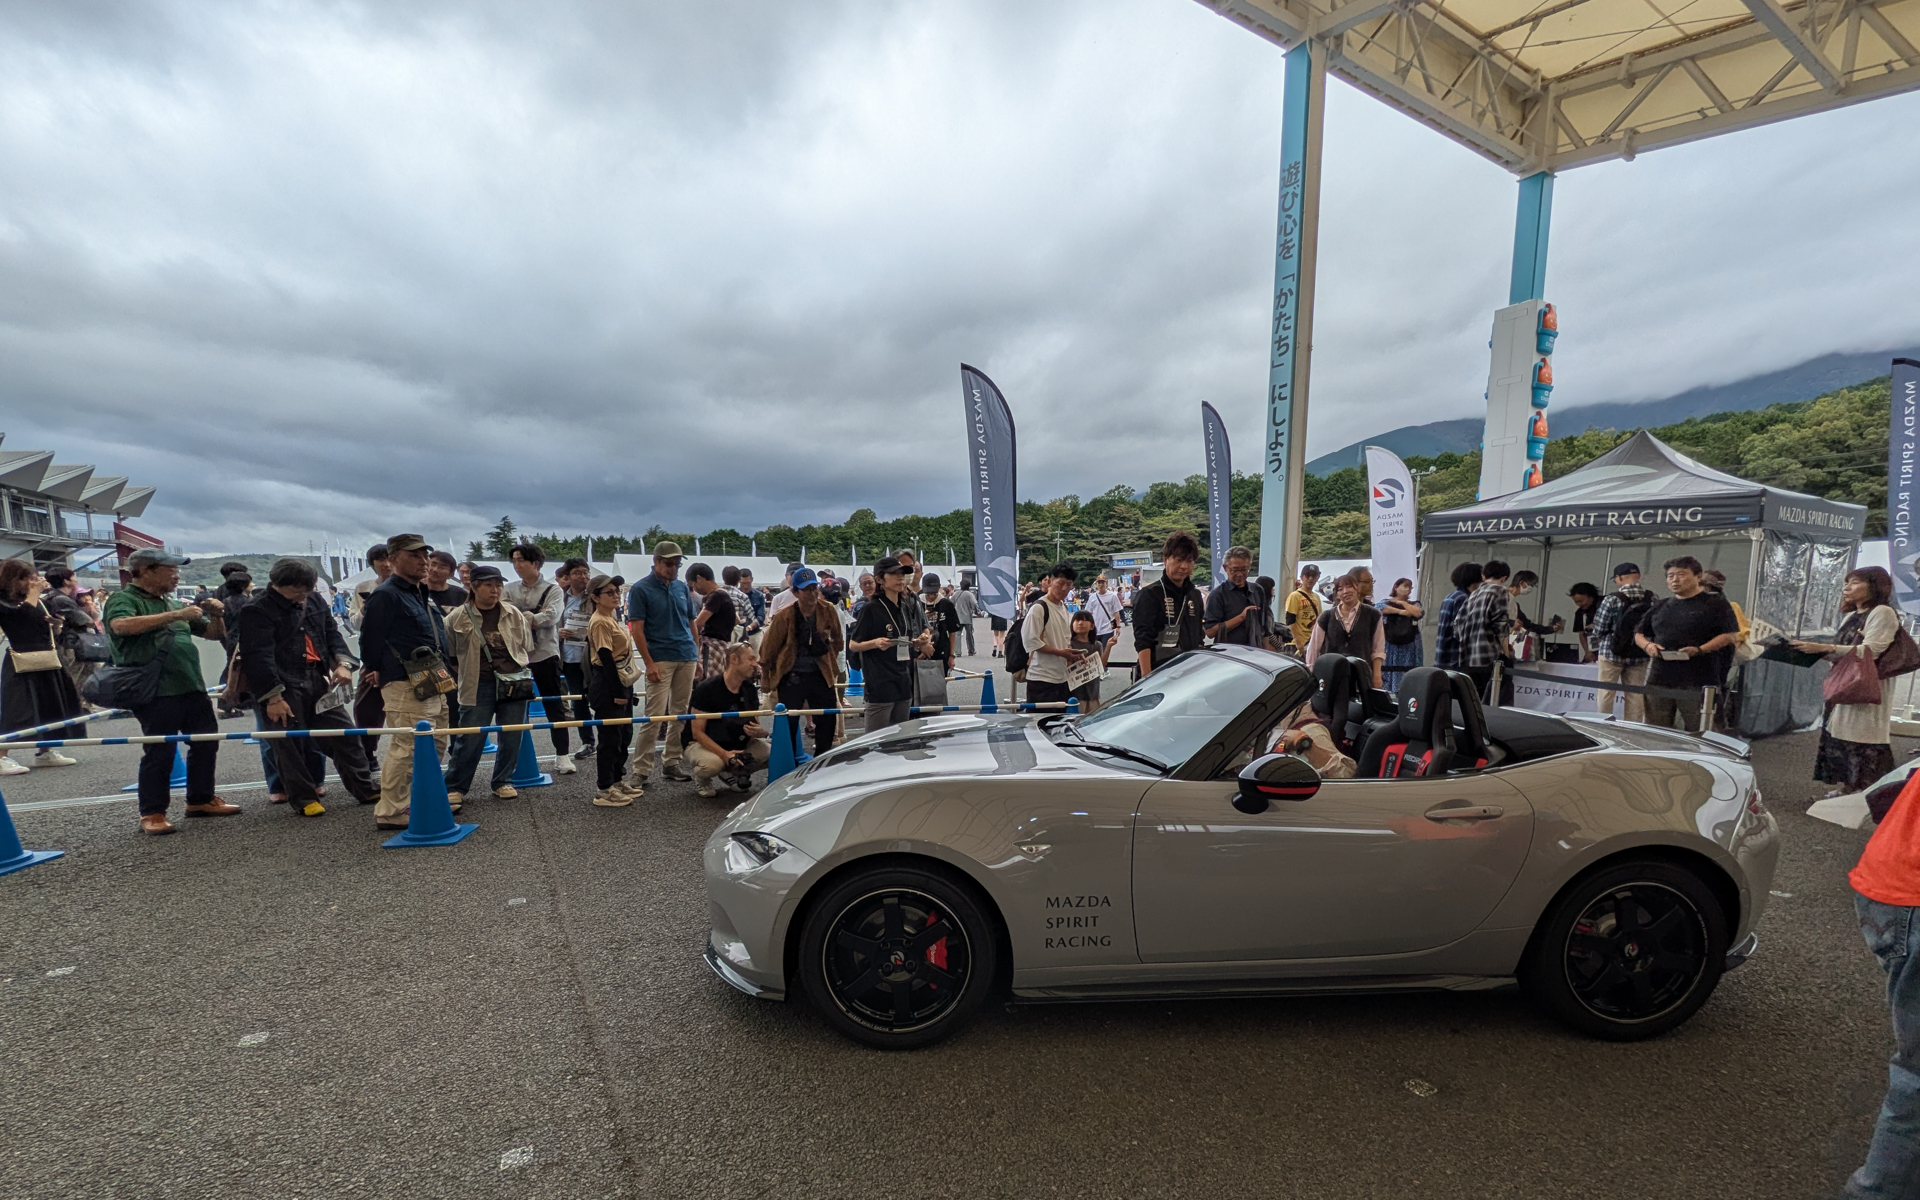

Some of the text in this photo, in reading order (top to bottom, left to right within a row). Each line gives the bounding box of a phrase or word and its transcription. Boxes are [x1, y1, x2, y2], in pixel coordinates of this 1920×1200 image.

[1456, 506, 1703, 533] MAZDA SPIRIT RACING
[1778, 505, 1855, 530] MAZDA SPIRIT RACING
[1515, 685, 1541, 696] ZDA
[1545, 688, 1584, 700] SPIRIT
[1045, 895, 1112, 909] MAZDA
[1045, 915, 1099, 929] SPIRIT
[1045, 935, 1112, 949] RACING
